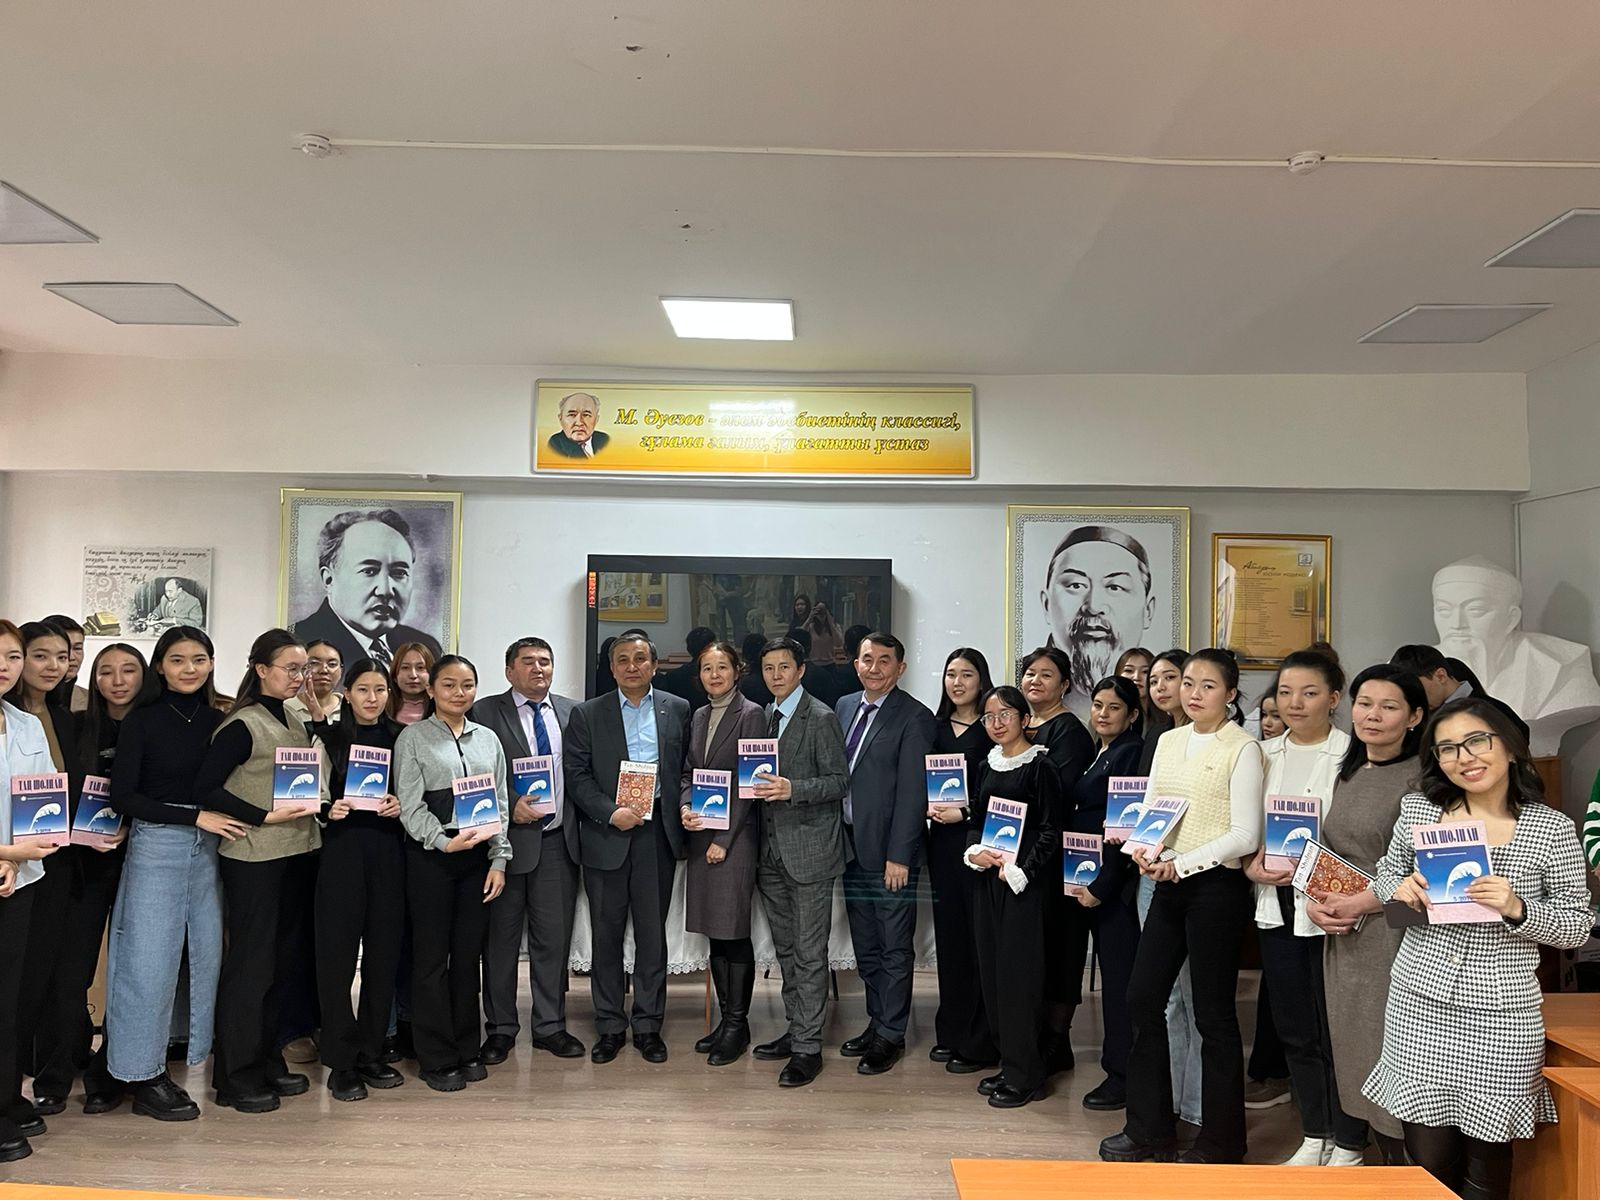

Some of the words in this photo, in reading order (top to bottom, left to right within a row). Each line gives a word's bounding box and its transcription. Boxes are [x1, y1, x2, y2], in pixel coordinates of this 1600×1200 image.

[614, 408, 638, 425] М.
[643, 408, 704, 429] Әуезов
[880, 411, 961, 431] классигі,
[1438, 827, 1479, 843] ШОЛПАН
